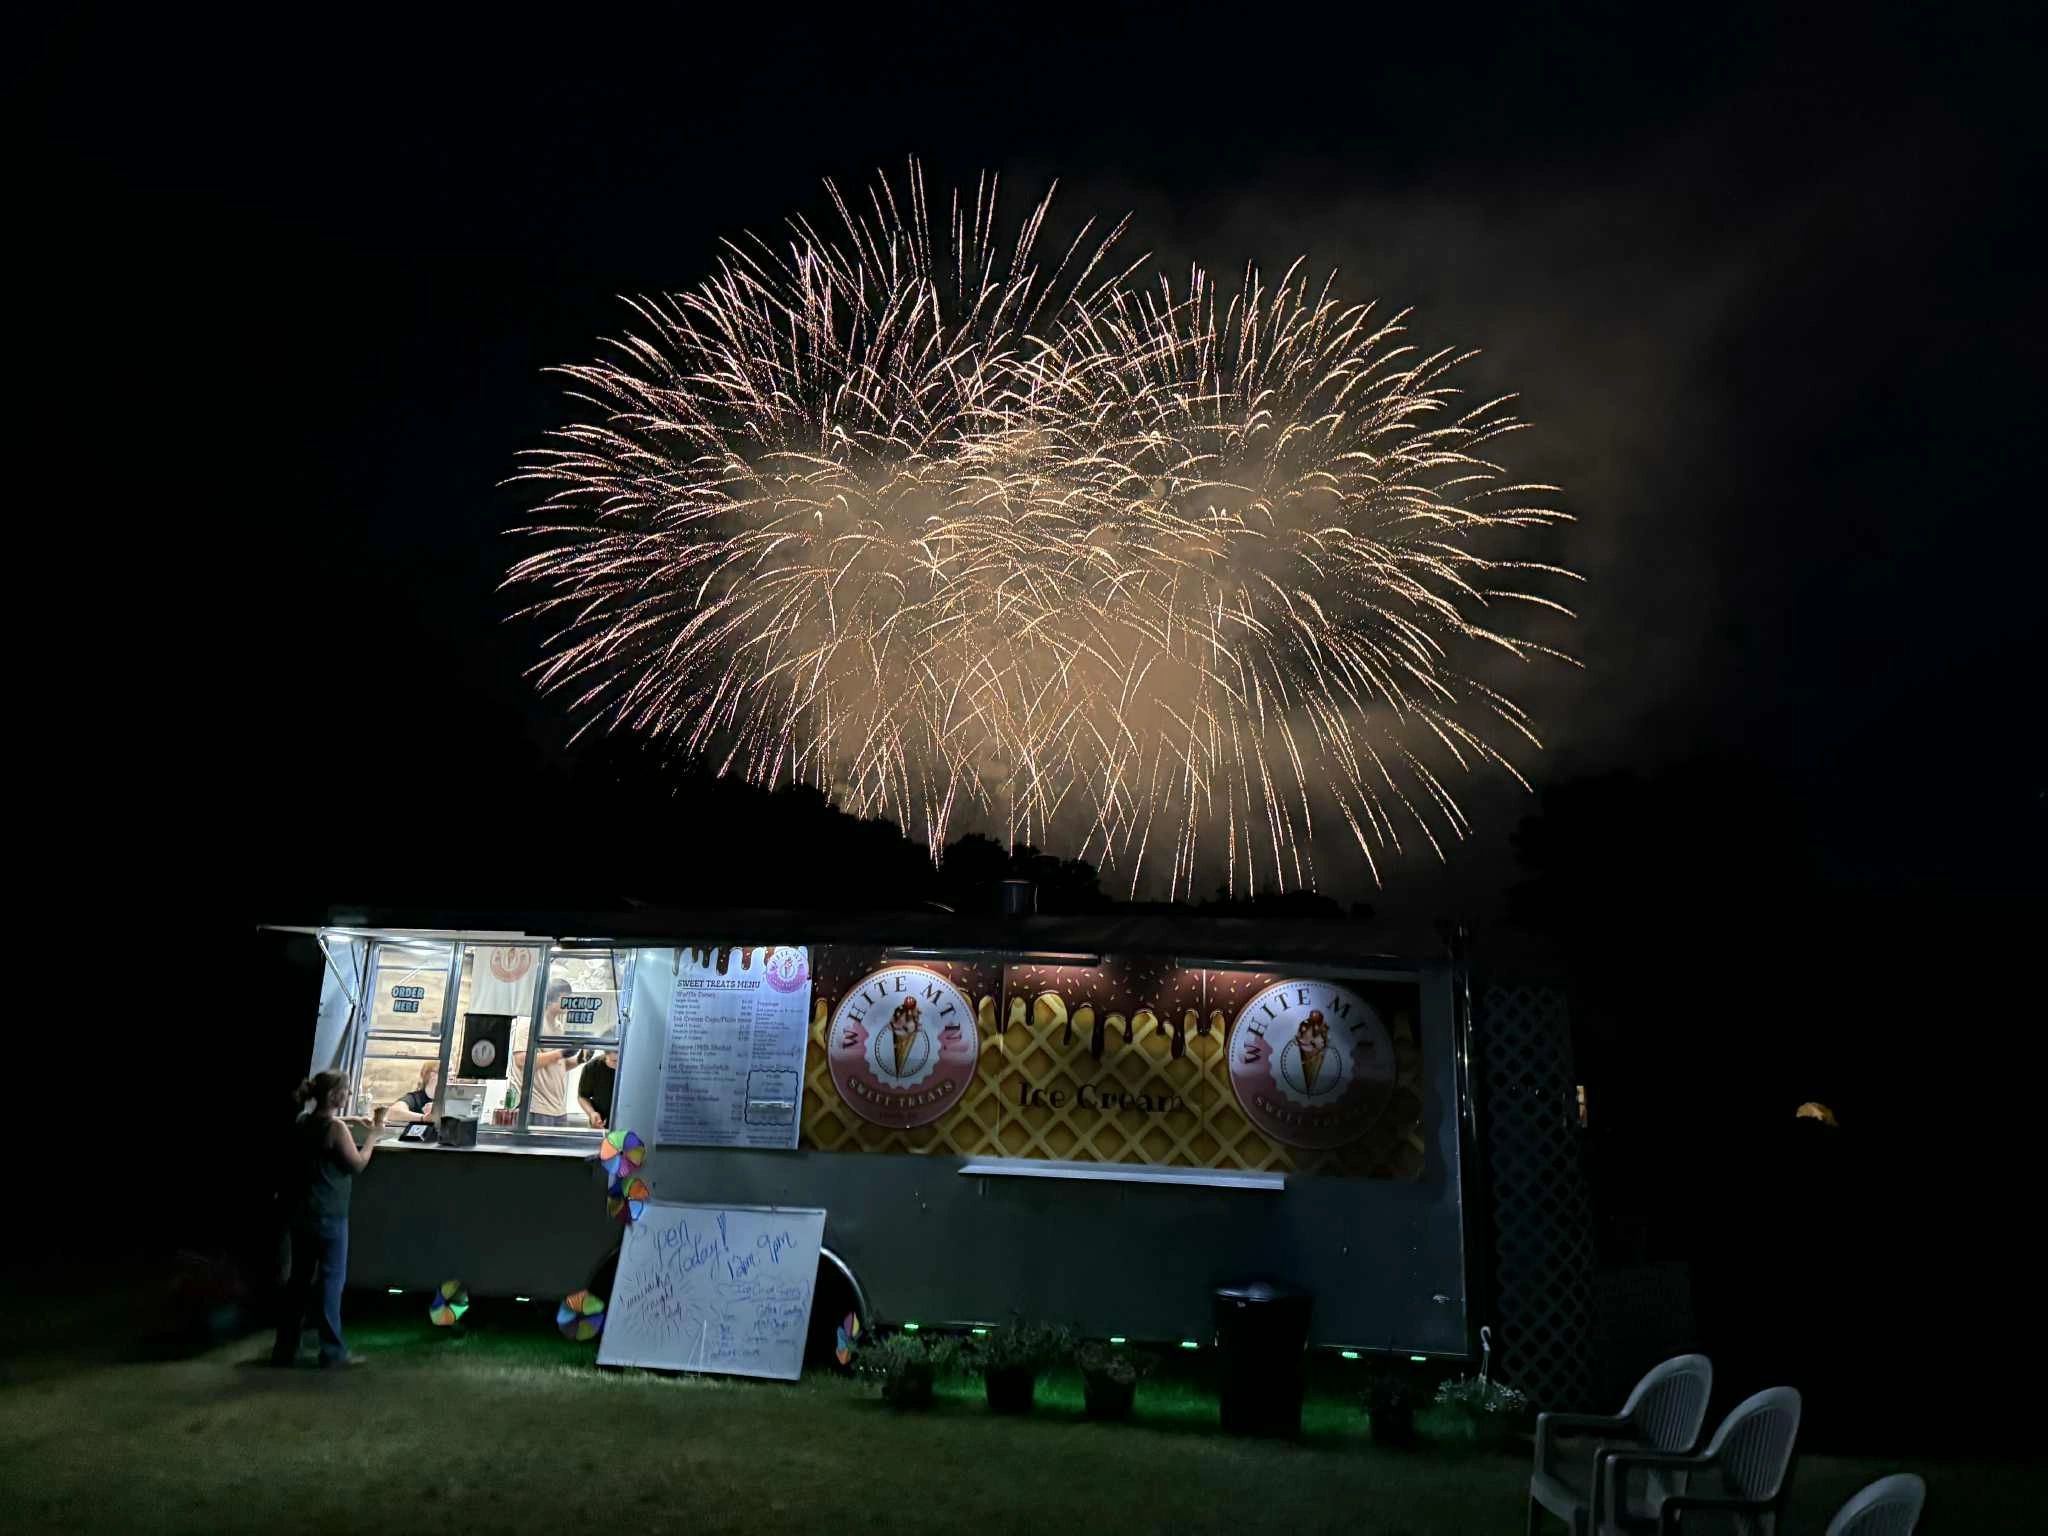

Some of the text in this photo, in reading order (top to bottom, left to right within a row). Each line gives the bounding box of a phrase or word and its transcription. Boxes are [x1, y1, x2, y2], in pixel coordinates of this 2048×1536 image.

[391, 985, 425, 999] ORDER
[677, 980, 704, 988] SWEET
[705, 980, 736, 988] TREATS
[737, 980, 760, 989] MENU
[393, 999, 419, 1013] HERE
[566, 1010, 594, 1024] HERE
[842, 975, 907, 1050] WHITE
[1243, 987, 1312, 1065] WHITE
[848, 1077, 954, 1108] SWEET TREATS
[1018, 1080, 1185, 1113] Ice Cream
[757, 1231, 798, 1265] 9pm
